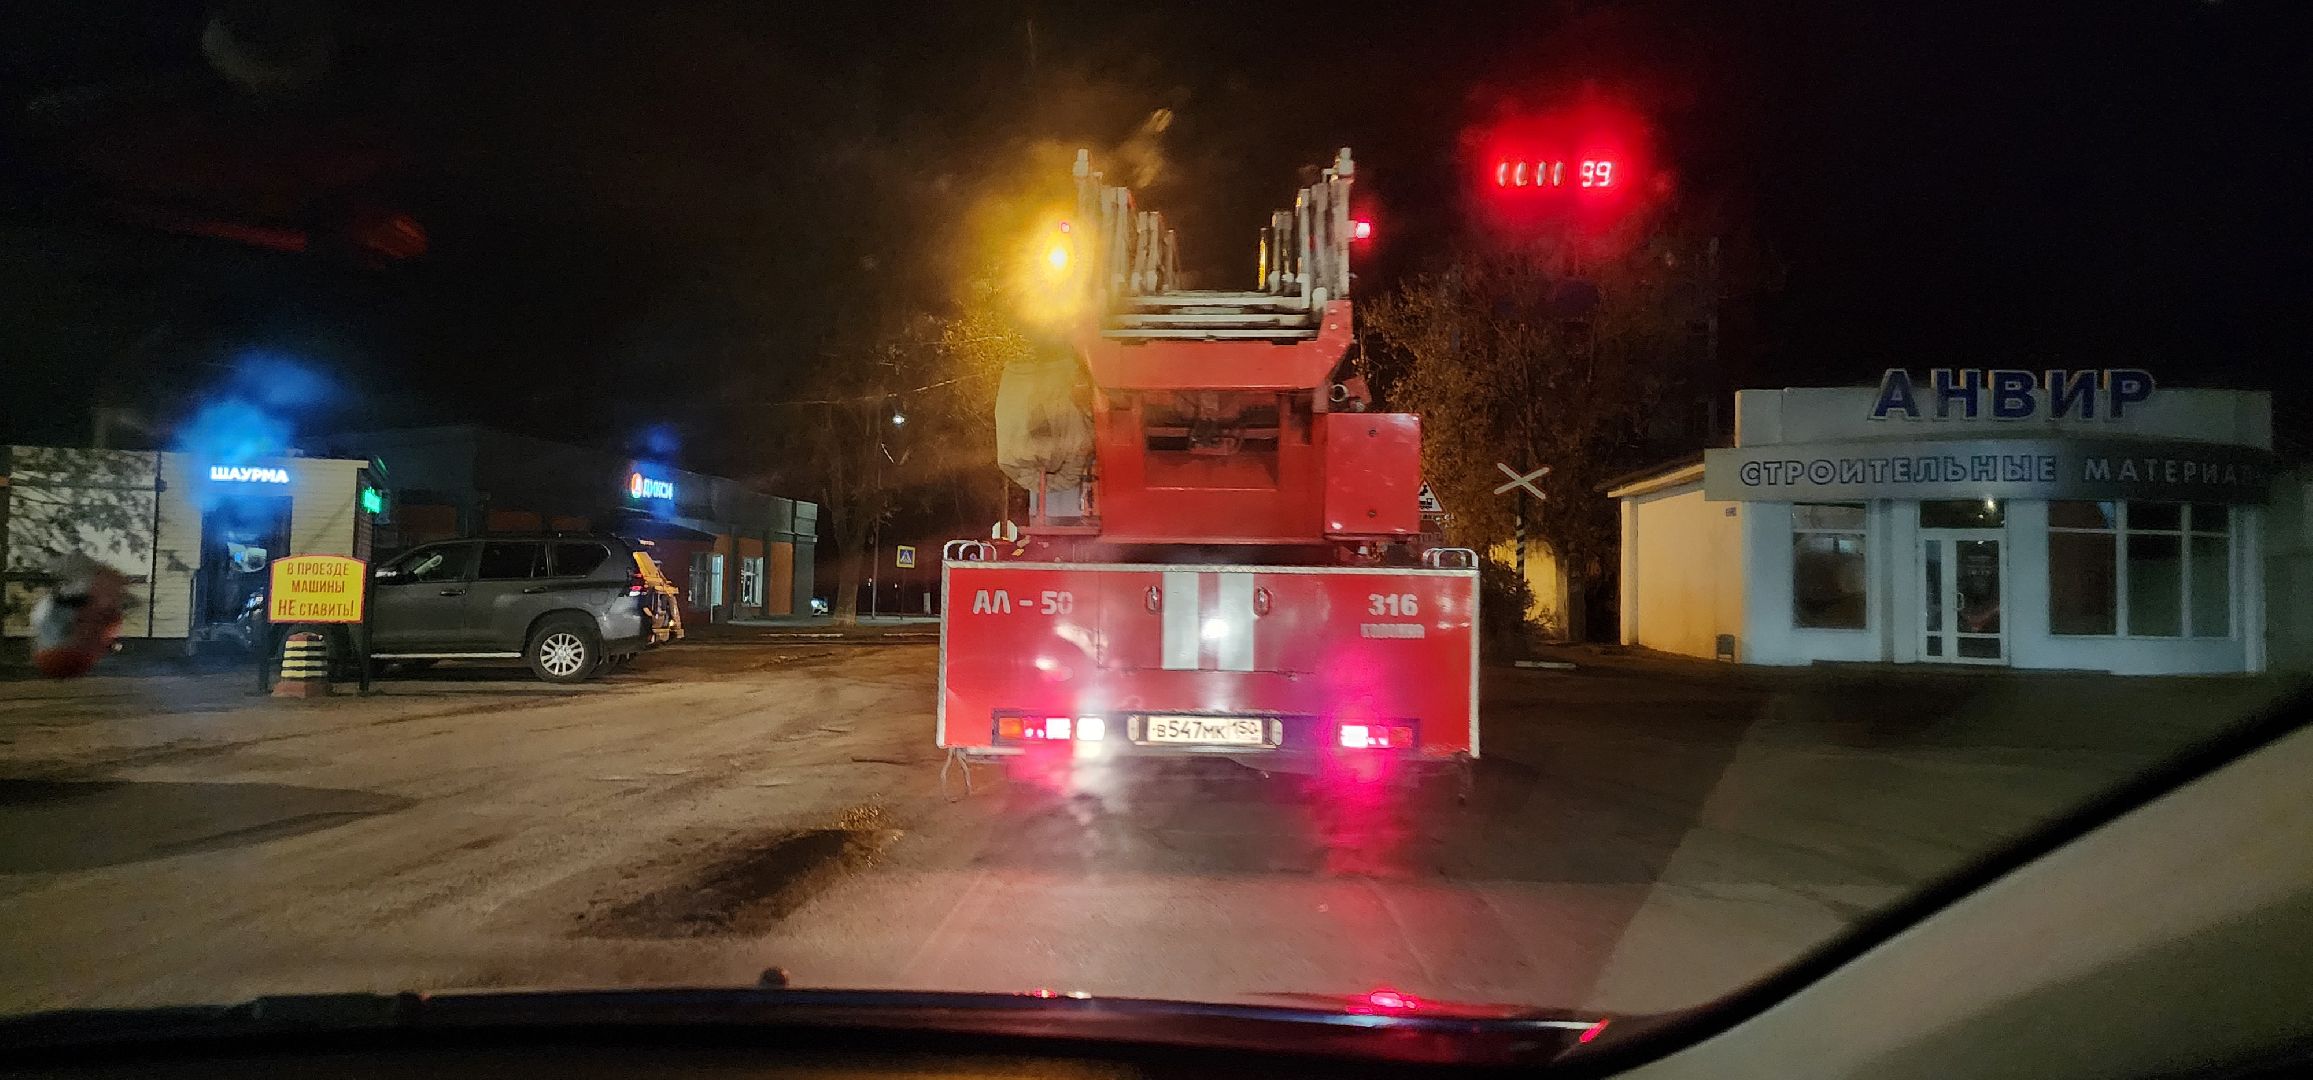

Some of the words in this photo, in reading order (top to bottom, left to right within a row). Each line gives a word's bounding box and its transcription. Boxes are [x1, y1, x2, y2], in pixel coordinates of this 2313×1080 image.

[1581, 160, 1612, 188] 99
[1867, 368, 2156, 421] АНВИР
[210, 466, 290, 484] ШАУРМА
[1740, 455, 2057, 487] СТРОИТЕЛЬНЫЕ
[2082, 458, 2268, 487] МАТЕРИАЛ
[287, 562, 294, 576] В
[297, 562, 350, 577] ПРОЕЗДЕ
[291, 580, 345, 593] МАШИНЫ
[278, 599, 297, 616] НЕ
[973, 589, 1011, 615] АЛ
[1040, 590, 1073, 615] 50
[1368, 593, 1418, 616] 316
